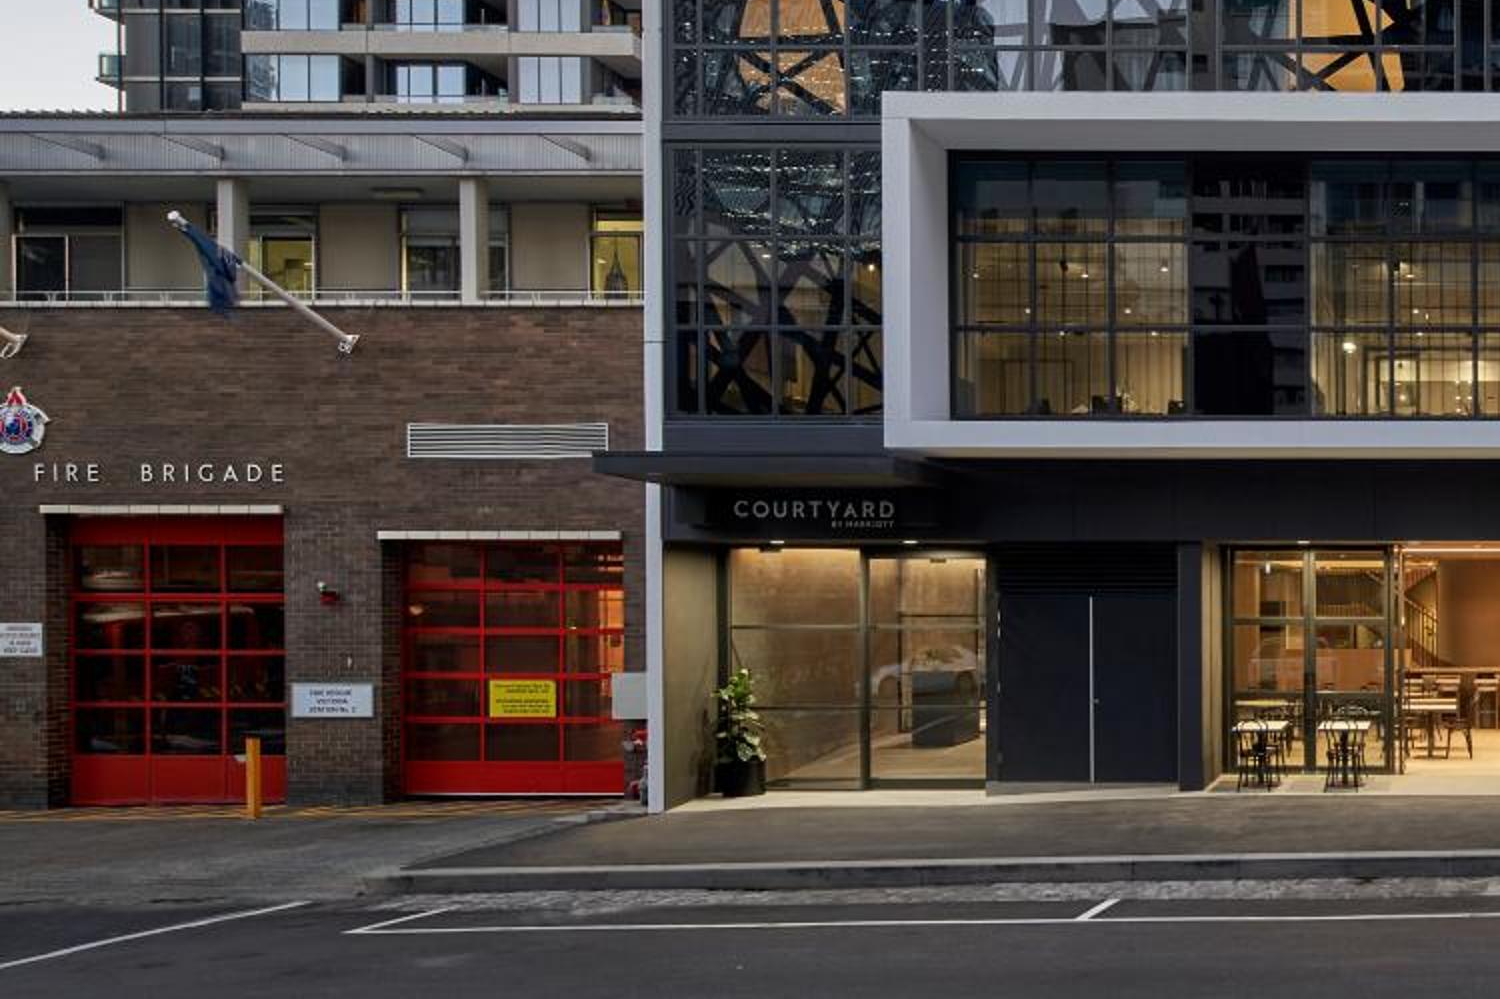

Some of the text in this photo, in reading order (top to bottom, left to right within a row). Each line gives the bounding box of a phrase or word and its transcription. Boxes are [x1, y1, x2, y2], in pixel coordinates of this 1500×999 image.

[33, 463, 284, 482] FIRE BRIGADE
[734, 500, 895, 518] COURTYARD
